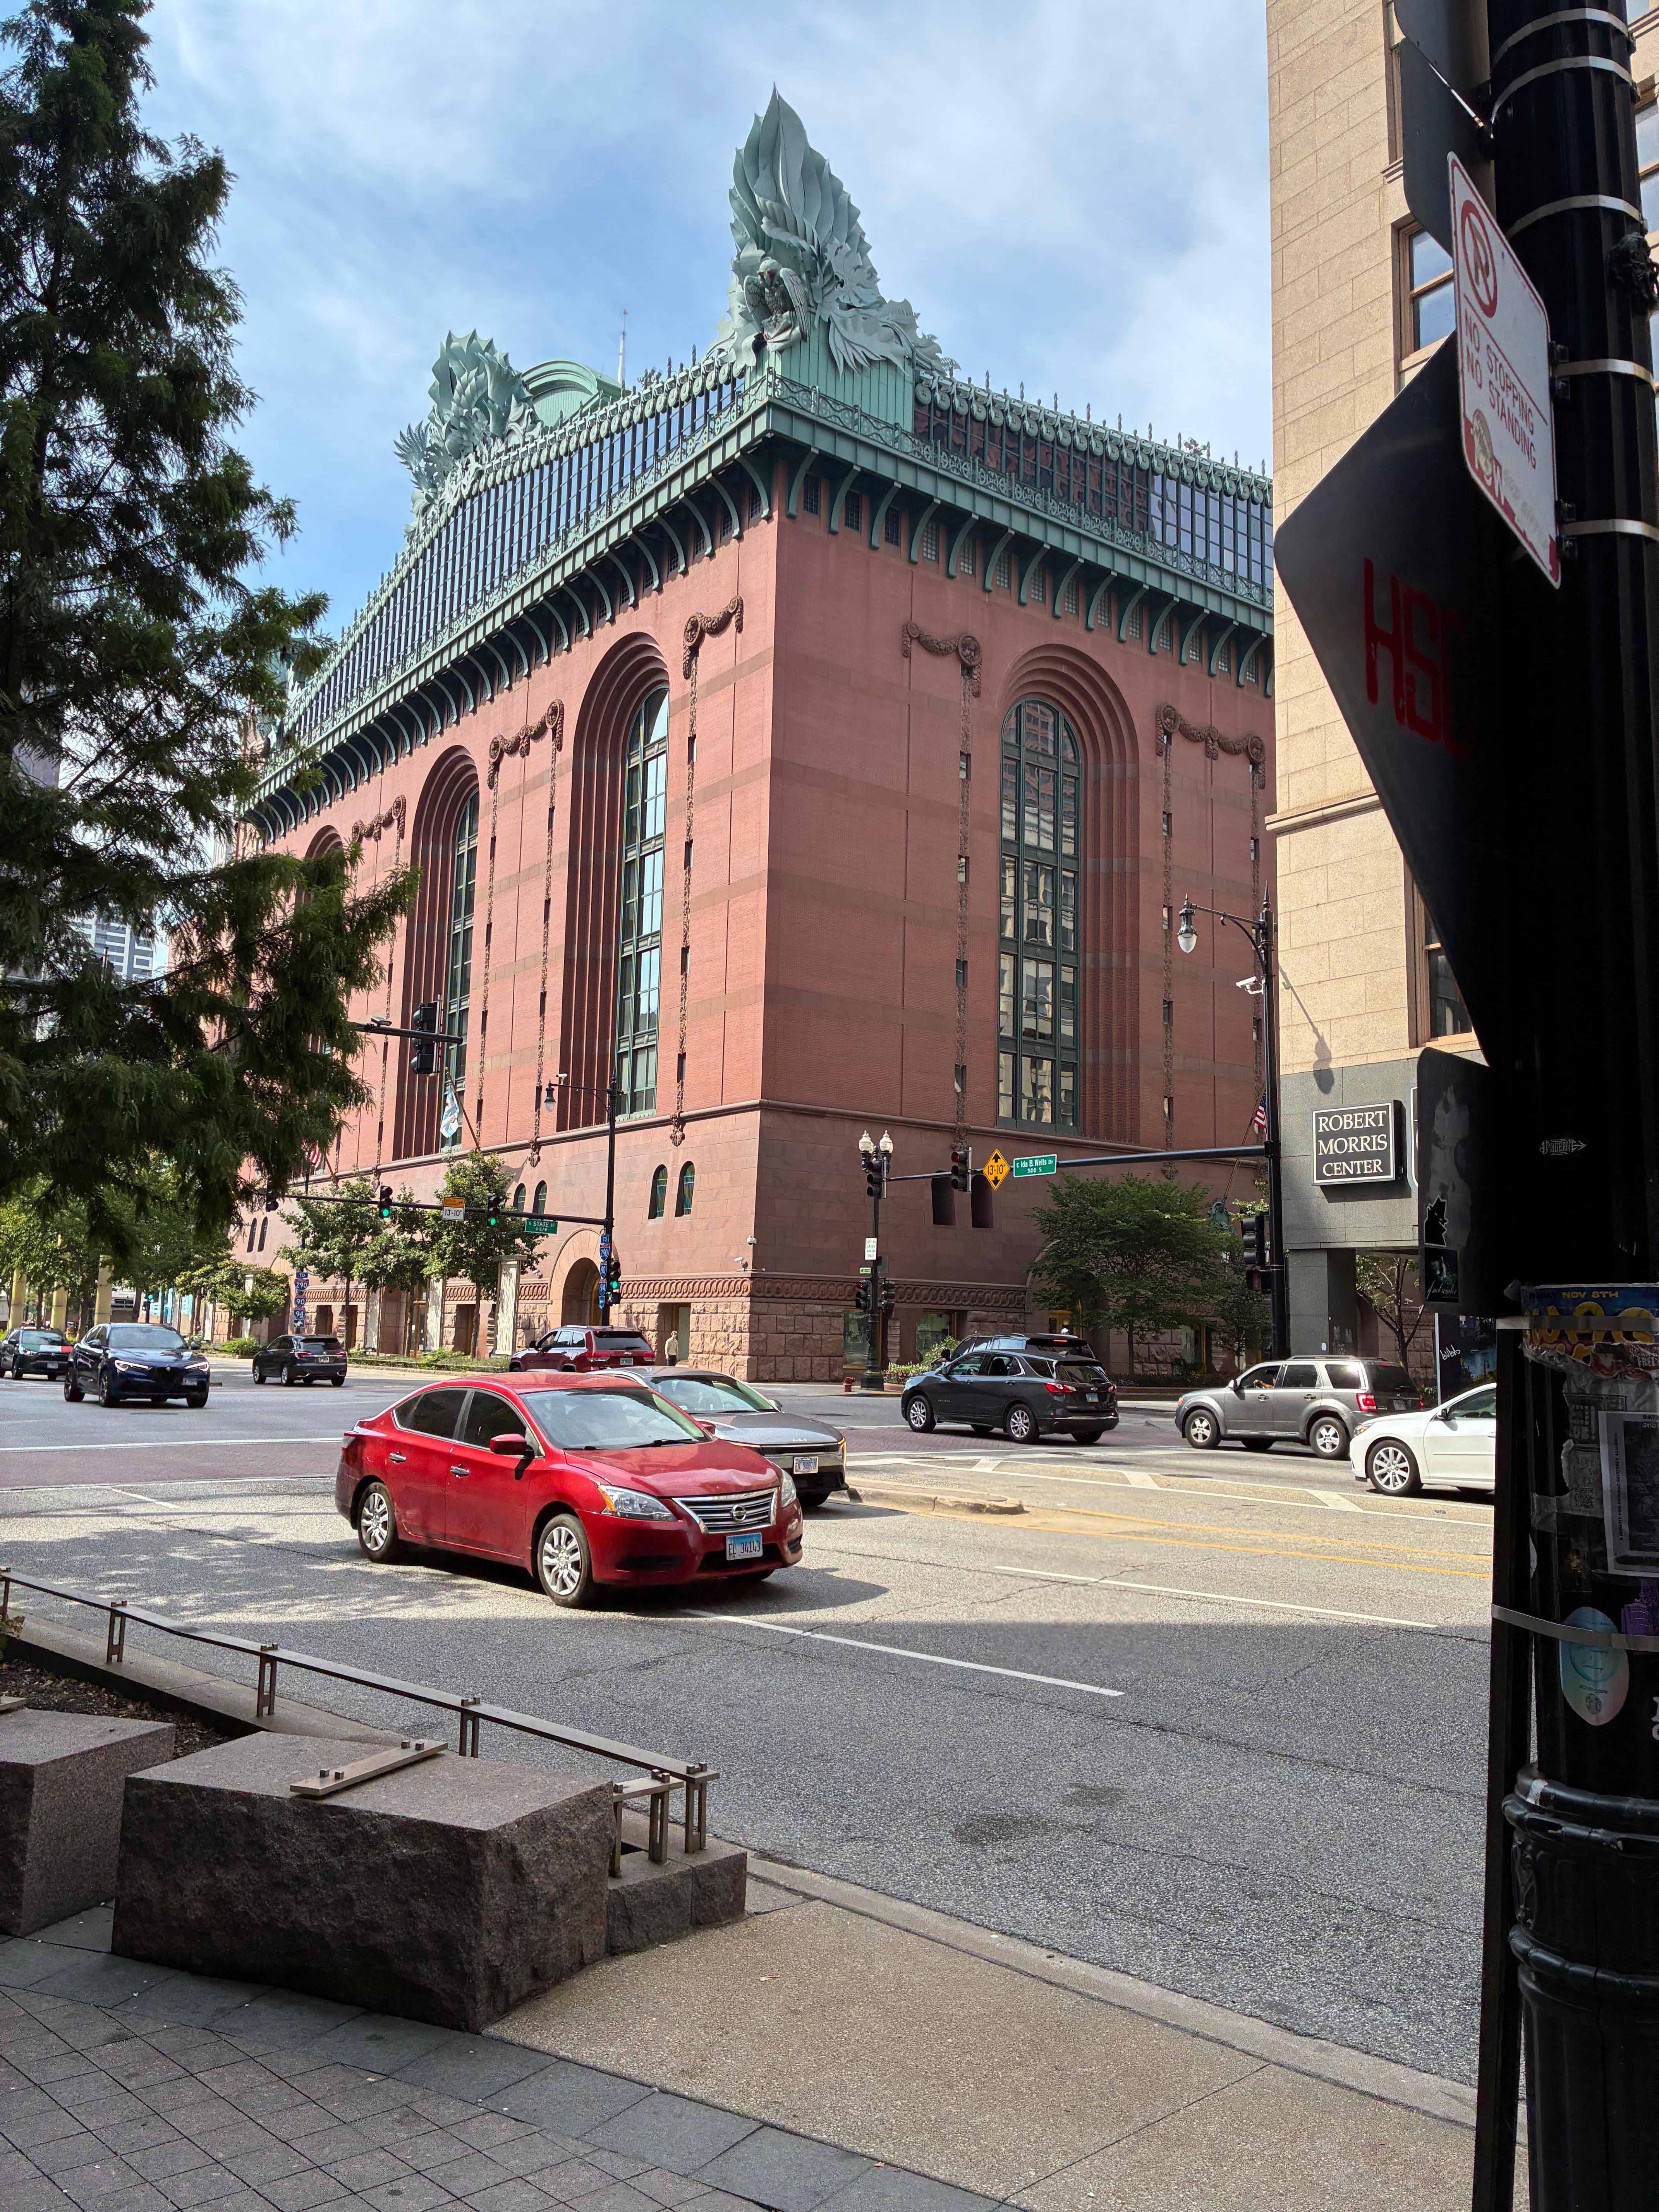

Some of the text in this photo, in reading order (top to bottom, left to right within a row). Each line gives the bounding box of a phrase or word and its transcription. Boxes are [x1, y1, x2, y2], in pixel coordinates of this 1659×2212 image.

[1465, 308, 1480, 353] NO
[1486, 344, 1534, 435] STOPPING
[1466, 345, 1482, 389] NO
[1489, 380, 1536, 470] STANDING
[1318, 1110, 1386, 1132] ROBERT
[1318, 1134, 1387, 1155] MORRIS
[1322, 1159, 1383, 1176] CENTER
[728, 1543, 736, 1555] EL
